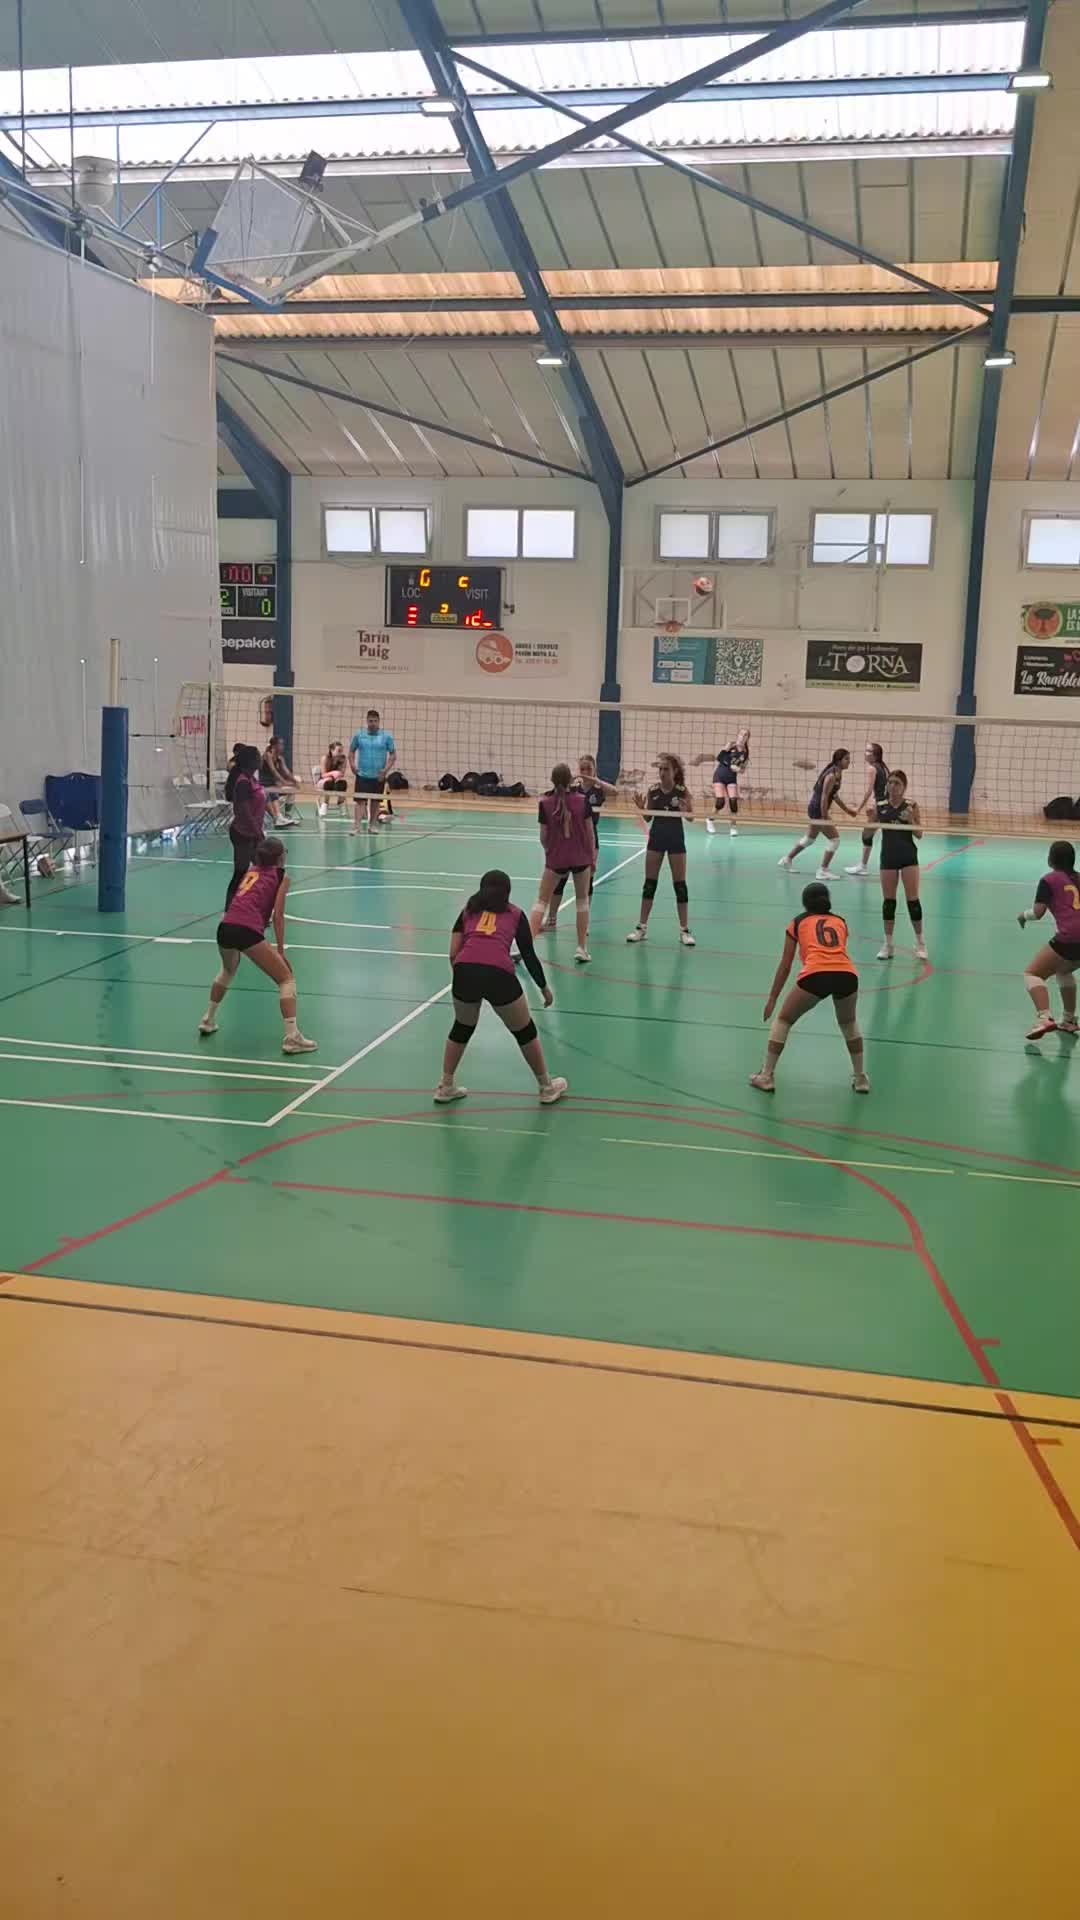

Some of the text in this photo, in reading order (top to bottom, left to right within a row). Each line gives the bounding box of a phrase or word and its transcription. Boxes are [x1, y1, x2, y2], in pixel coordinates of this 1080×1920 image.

[465, 589, 488, 600] VISIT
[359, 644, 390, 661] Puig
[475, 911, 497, 936] 4
[815, 918, 840, 948] 6
